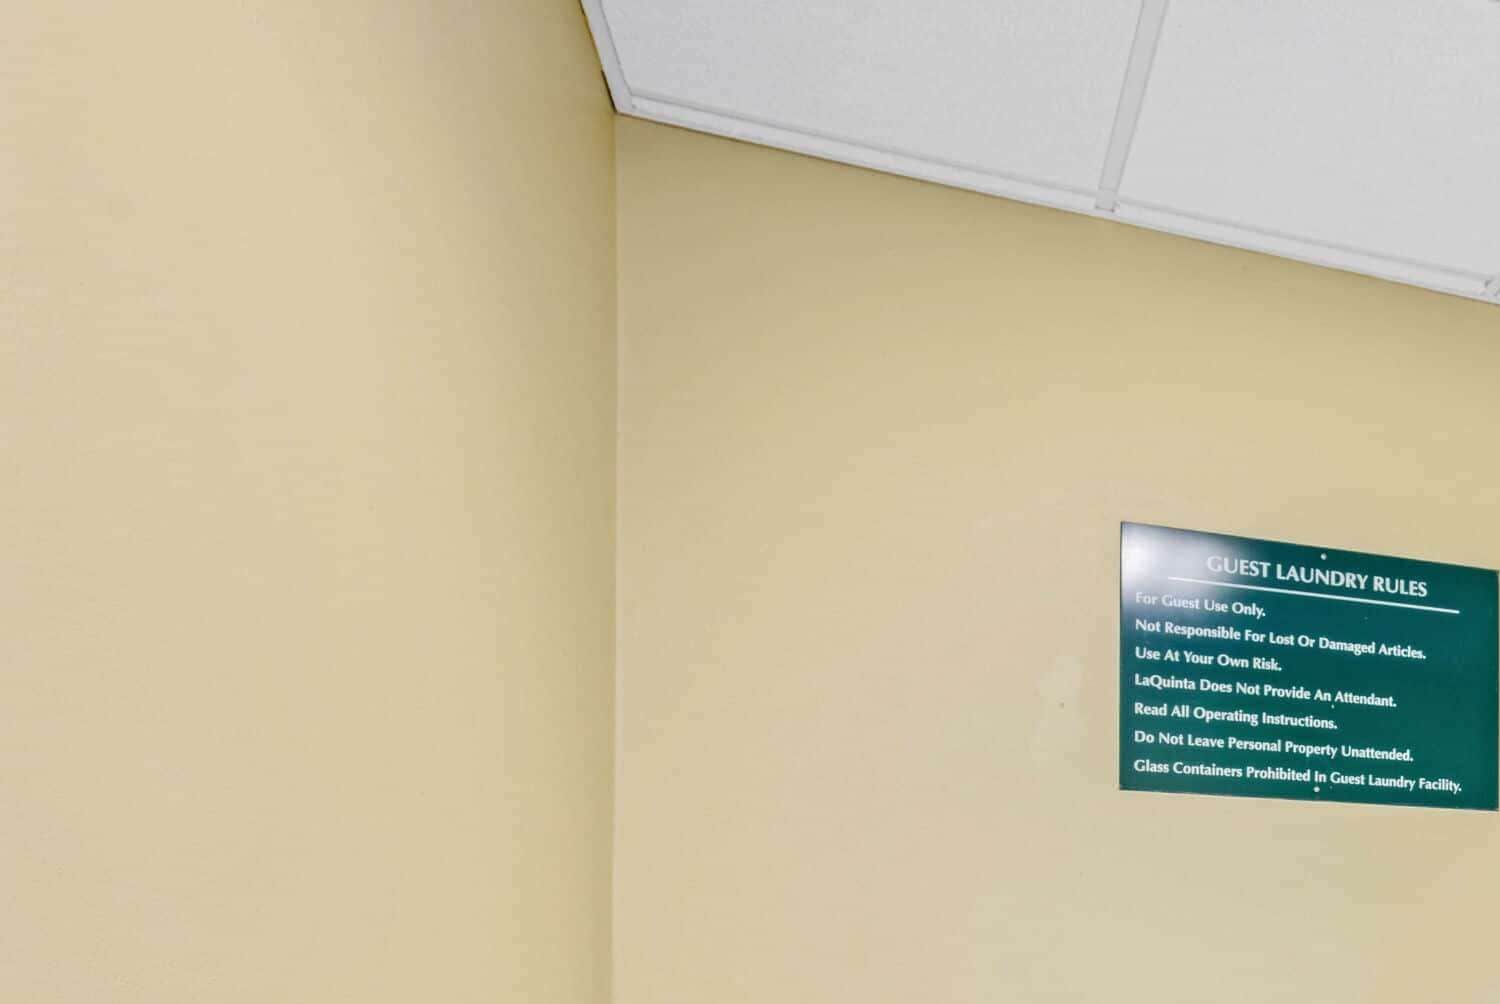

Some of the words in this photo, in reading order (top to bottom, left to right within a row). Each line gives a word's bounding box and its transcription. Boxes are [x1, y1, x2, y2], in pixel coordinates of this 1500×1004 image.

[1207, 555, 1271, 578] GUEST
[1276, 564, 1368, 590] LAUNDRY
[1373, 576, 1427, 597] RULES
[1135, 592, 1158, 606] For
[1161, 595, 1200, 610] Guest
[1204, 599, 1228, 612] Use
[1232, 601, 1266, 619] Only.
[1135, 619, 1160, 633] Not
[1165, 622, 1241, 641] Responsible
[1245, 629, 1266, 643] For
[1269, 631, 1294, 645] Lost
[1297, 635, 1315, 647] Or
[1319, 636, 1376, 656] Damaged
[1378, 643, 1426, 659] Articles.
[1135, 647, 1161, 661] Use
[1164, 649, 1180, 662] At
[1184, 651, 1214, 665] Your
[1217, 654, 1249, 668] Own
[1253, 657, 1282, 671] Risk.
[1135, 673, 1196, 691] LaQuinta
[1200, 678, 1233, 693] Does
[1236, 682, 1260, 696] Not
[1264, 684, 1311, 700] Provide
[1314, 689, 1331, 702] An
[1335, 690, 1397, 707] Attendant.
[1134, 702, 1167, 717] Read
[1171, 705, 1190, 718] All
[1193, 707, 1259, 726] Operating
[1262, 712, 1337, 729] Instructions.
[1134, 730, 1155, 744] Do
[1158, 732, 1184, 746] Not
[1187, 734, 1225, 748] Leave
[1228, 737, 1281, 753] Personal
[1285, 741, 1338, 759] Property
[1341, 745, 1413, 762] Unattended.
[1134, 759, 1169, 774] Glass
[1173, 762, 1243, 778] Containers
[1246, 766, 1311, 782] Prohibited
[1314, 771, 1327, 783] In
[1330, 772, 1365, 786] Guest
[1368, 774, 1416, 791] Laundry
[1419, 778, 1462, 794] Facility.
